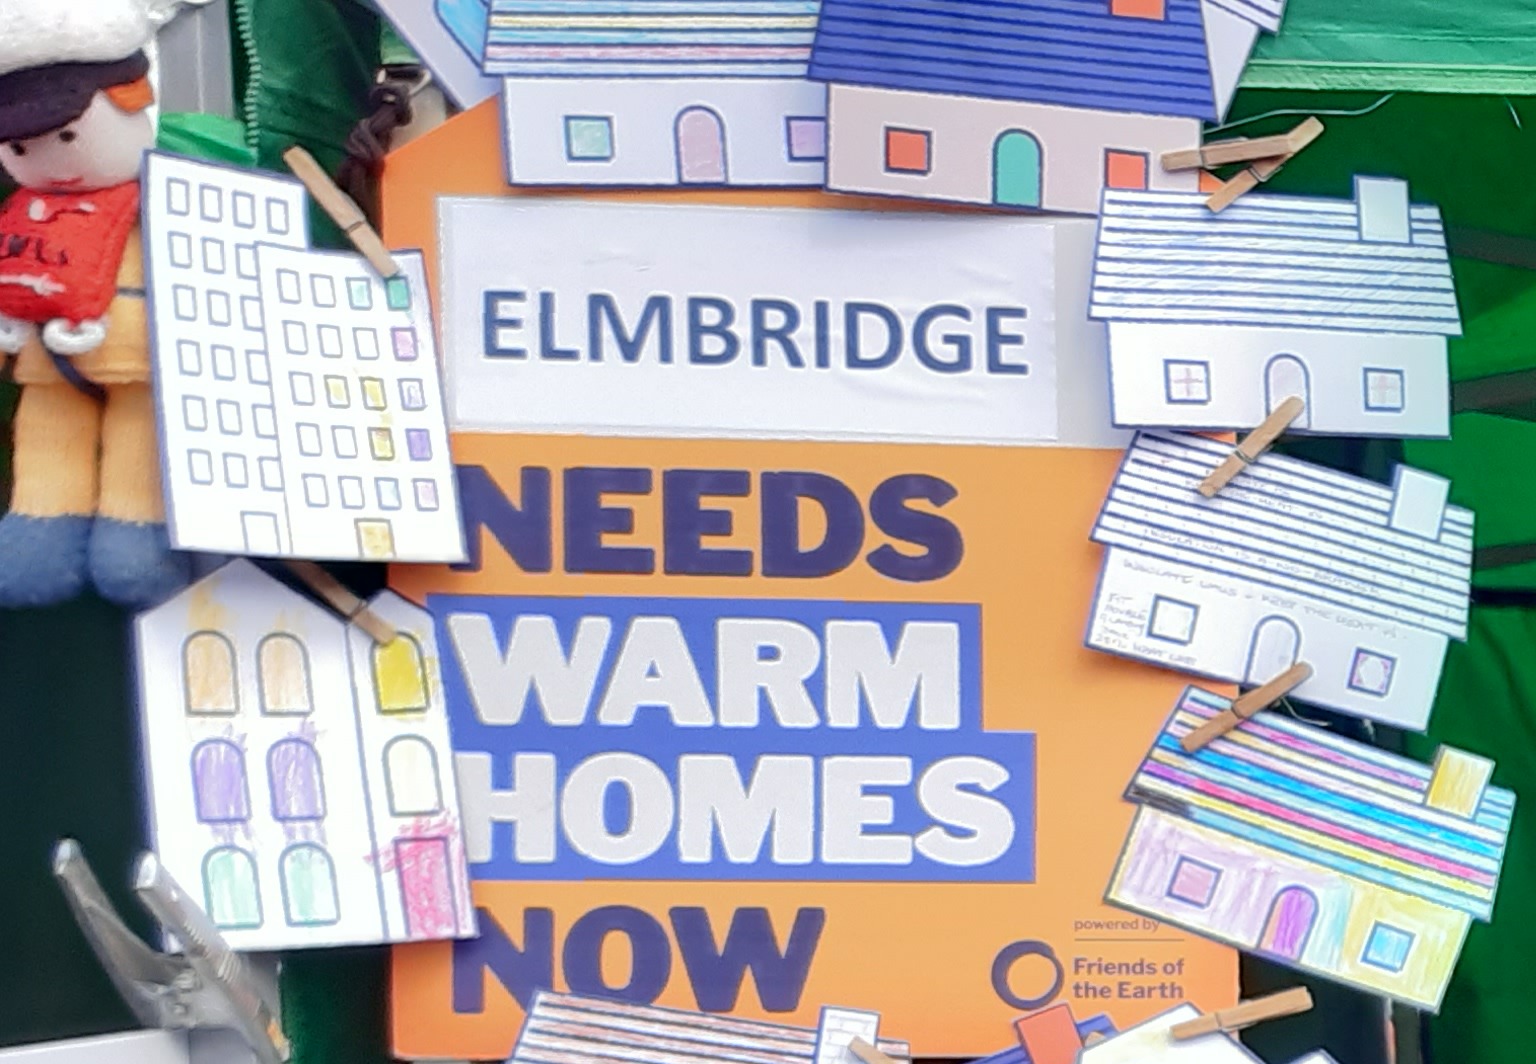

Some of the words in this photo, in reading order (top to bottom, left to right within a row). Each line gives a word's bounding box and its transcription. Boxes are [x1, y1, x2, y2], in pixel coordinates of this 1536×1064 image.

[482, 290, 1030, 375] ELMBRIDGE
[450, 465, 965, 582] NEEDS
[448, 615, 962, 731] WARM
[454, 750, 1016, 866] HOMES
[452, 904, 826, 1014] NOW
[1073, 957, 1157, 976] Friends
[1163, 956, 1184, 976] of
[1074, 918, 1138, 932] powered
[1142, 918, 1161, 932] by
[1073, 980, 1111, 999] the
[1118, 980, 1184, 999] Earth
